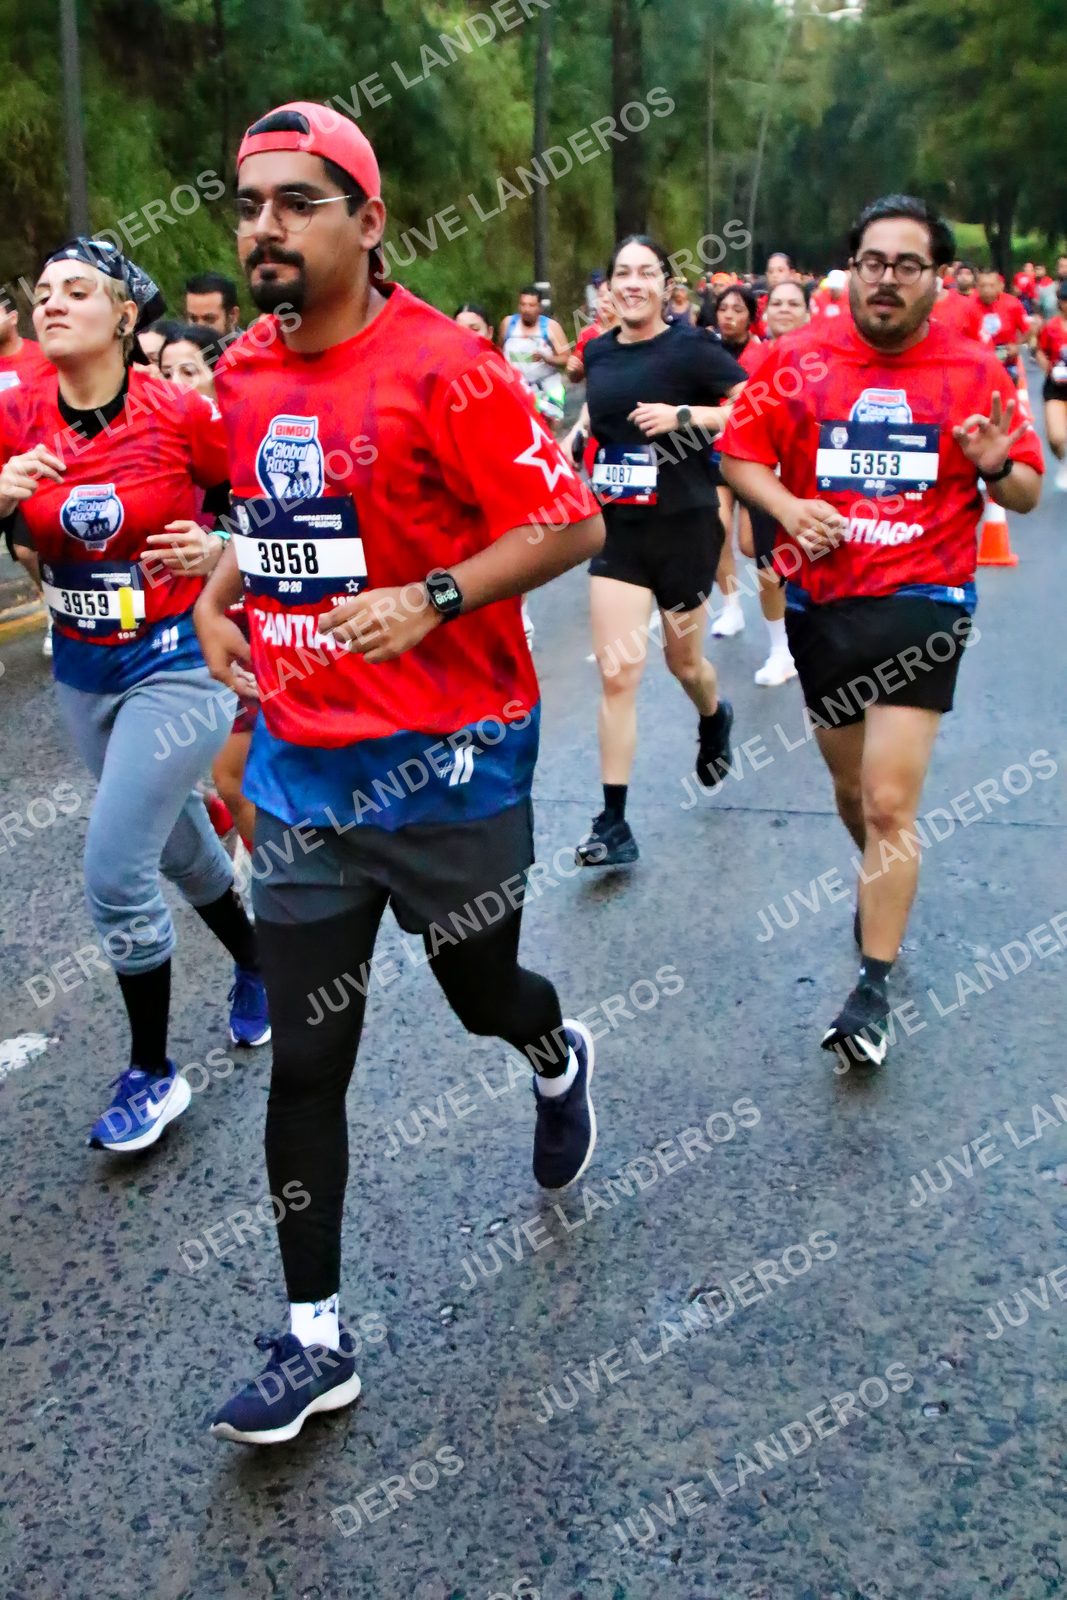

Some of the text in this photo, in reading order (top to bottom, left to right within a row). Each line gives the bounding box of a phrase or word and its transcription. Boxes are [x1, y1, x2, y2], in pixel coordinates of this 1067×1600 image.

[275, 424, 311, 438] BIMBO
[272, 442, 308, 460] Global
[266, 456, 295, 473] Race
[850, 453, 901, 476] 5353
[606, 466, 633, 484] 4087
[76, 500, 108, 512] Global
[70, 511, 96, 522] Race
[258, 542, 319, 574] 3958
[61, 591, 110, 616] 3959
